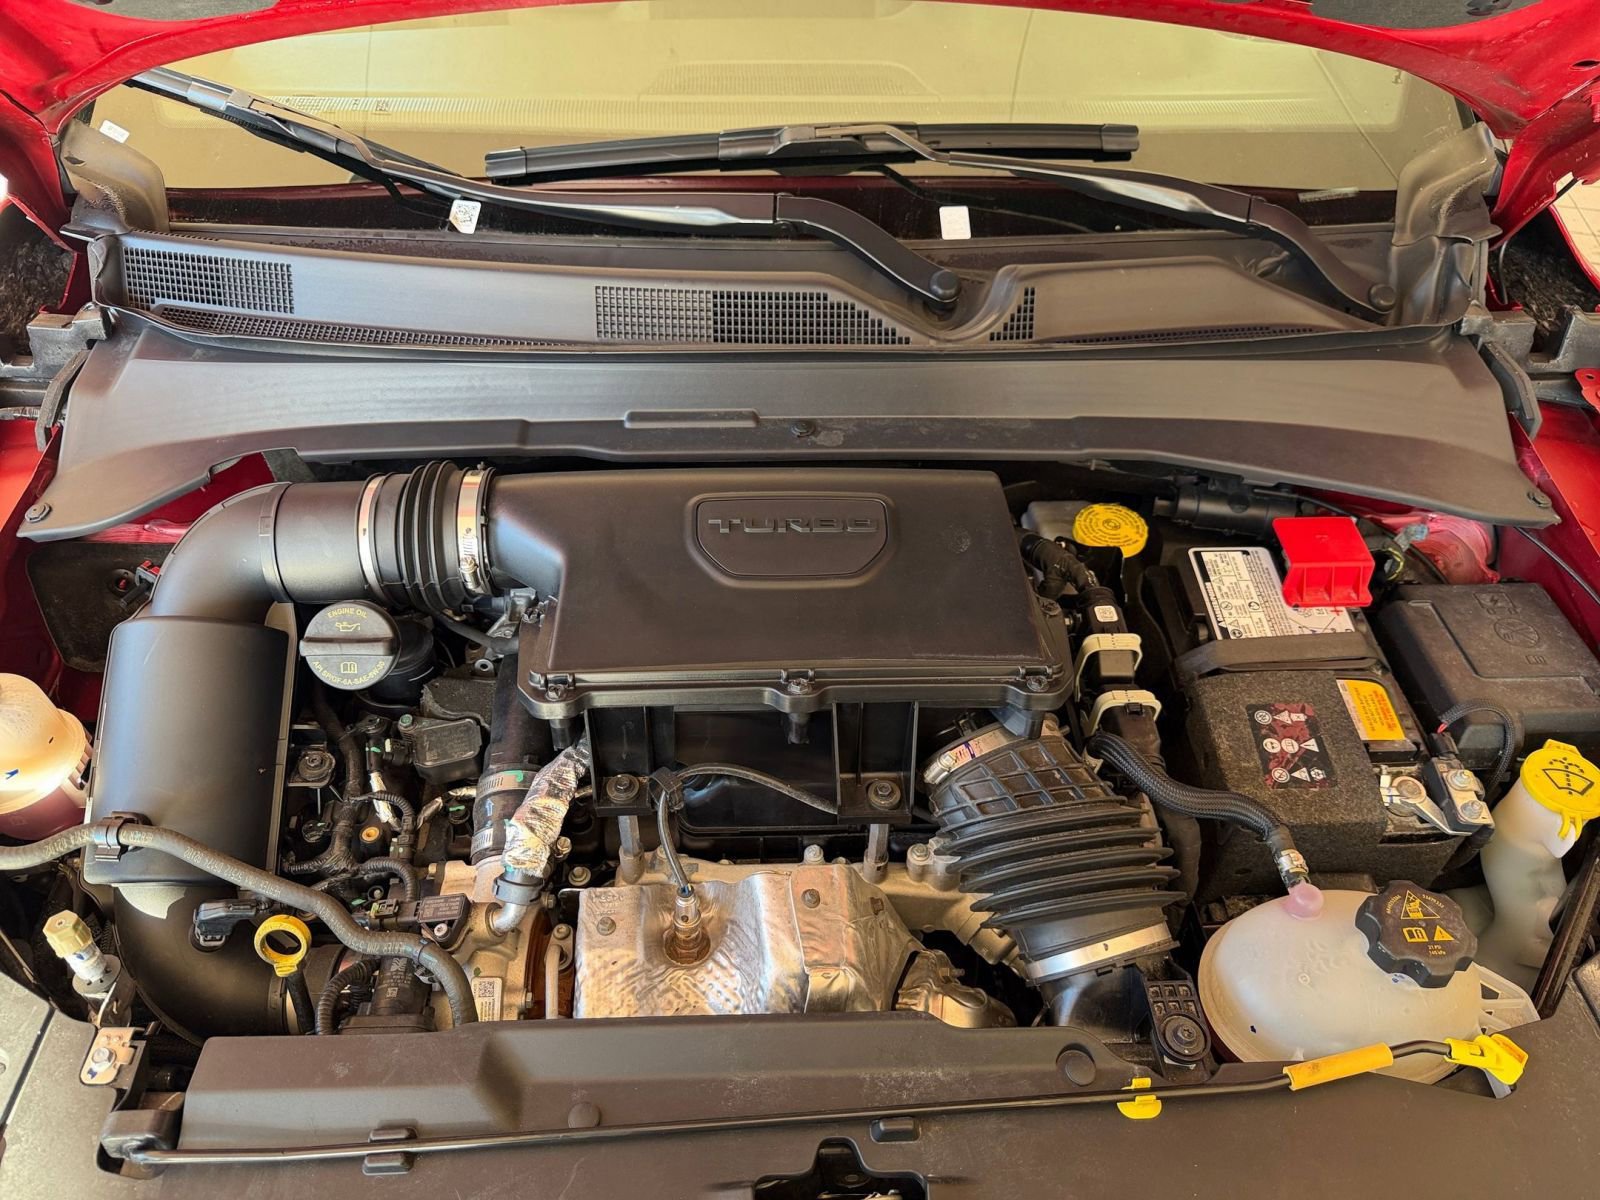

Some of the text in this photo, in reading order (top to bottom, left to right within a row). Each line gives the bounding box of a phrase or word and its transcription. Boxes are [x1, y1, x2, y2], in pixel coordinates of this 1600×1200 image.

[708, 517, 879, 534] TURBO
[327, 607, 368, 619] ENGINE OIL
[312, 661, 323, 672] API
